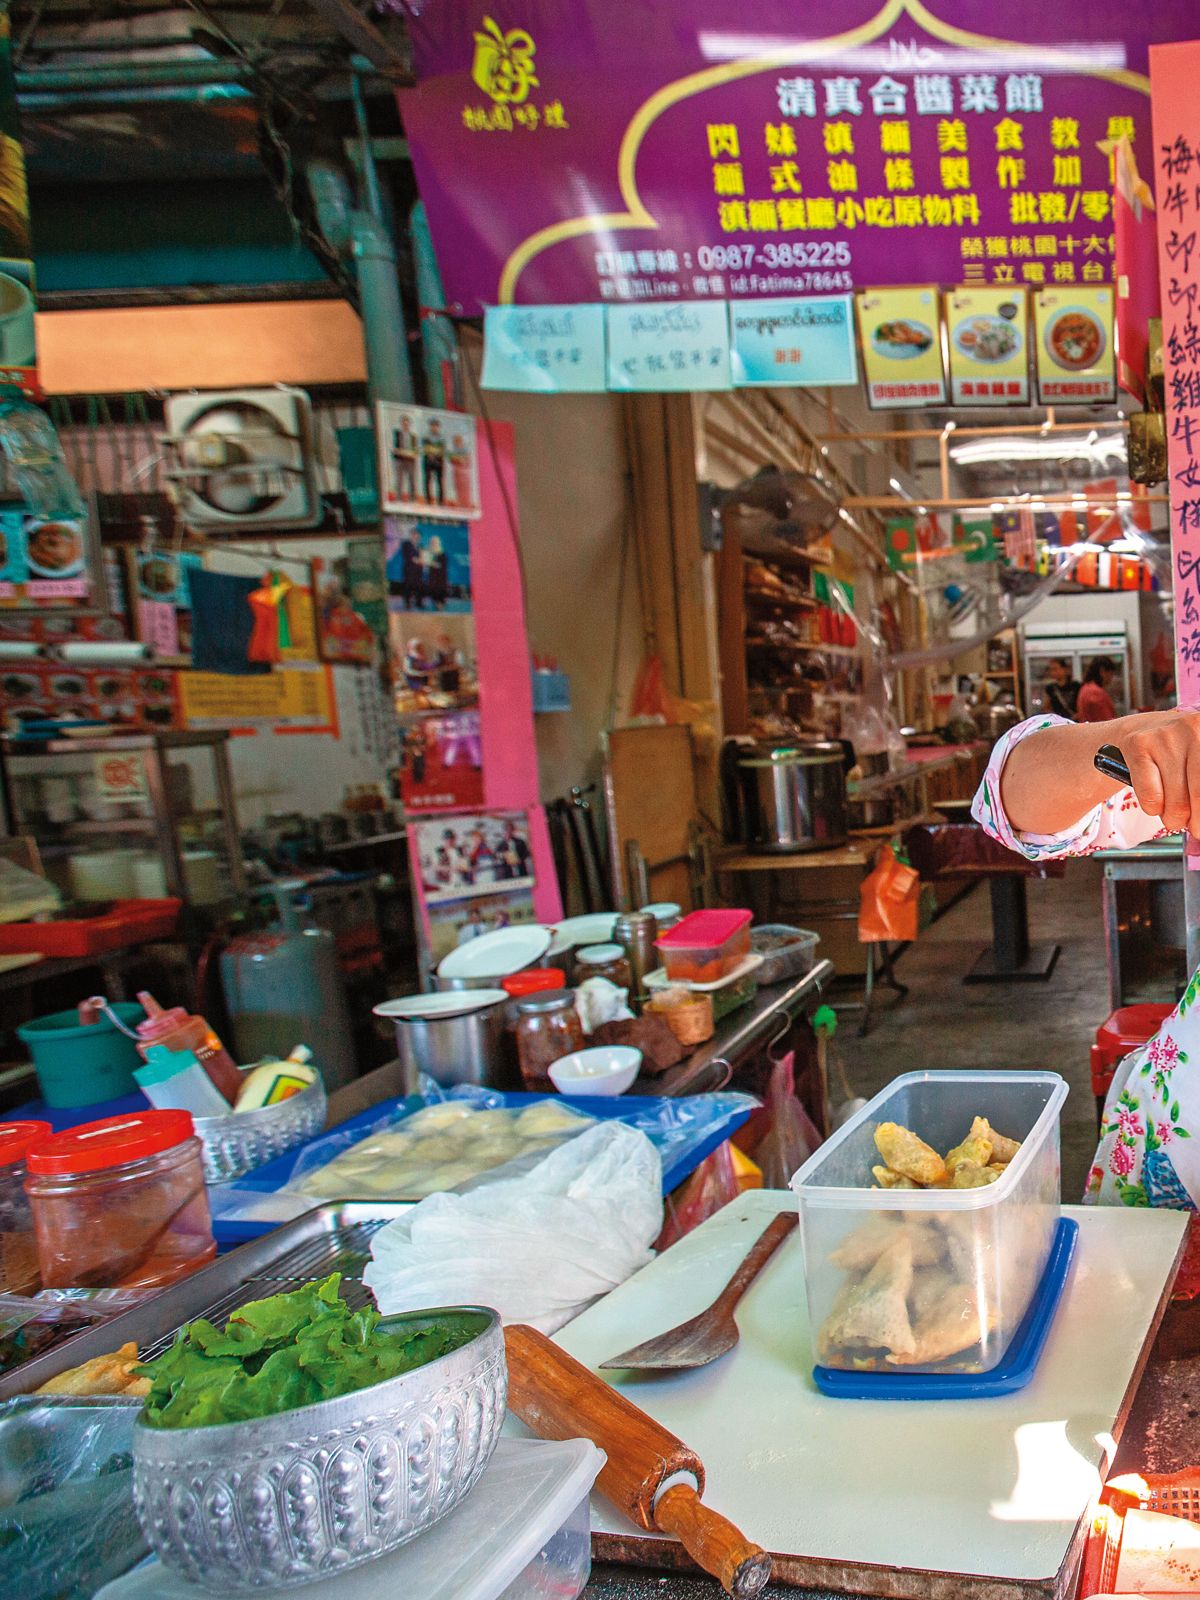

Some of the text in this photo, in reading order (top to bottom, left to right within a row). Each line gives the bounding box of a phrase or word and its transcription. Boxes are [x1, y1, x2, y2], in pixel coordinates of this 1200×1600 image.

[713, 155, 1115, 196] 緬式油條製作加
[1010, 191, 1116, 225] 批發/零
[697, 242, 851, 271] 0987-385225
[963, 260, 1116, 285] 三立電視台
